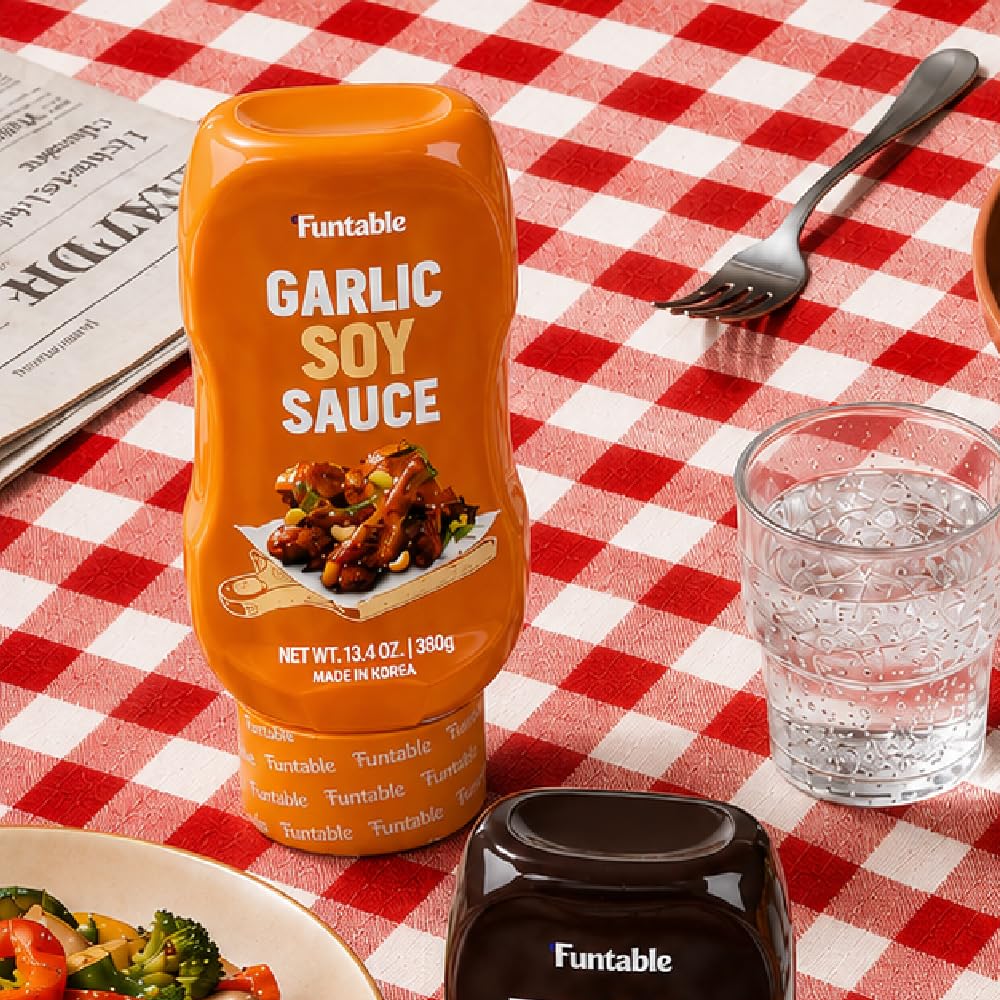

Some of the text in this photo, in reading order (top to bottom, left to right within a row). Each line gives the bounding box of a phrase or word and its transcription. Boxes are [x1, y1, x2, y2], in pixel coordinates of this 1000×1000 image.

[297, 211, 406, 238] Funtable
[266, 259, 442, 317] GARLIC
[301, 318, 414, 380] SOY
[282, 378, 440, 434] SAUCE
[279, 647, 310, 664] NET
[379, 641, 404, 659] OZ.
[416, 634, 455, 654] 380g
[313, 663, 416, 683] MADE IN KOREA
[264, 753, 336, 774] Funtable
[352, 739, 432, 768] Funtable
[250, 780, 308, 808] Funtable
[323, 783, 406, 807] Funtable
[280, 821, 353, 841] Funtable
[368, 806, 444, 836] Funtable
[554, 942, 673, 973] Funtable
